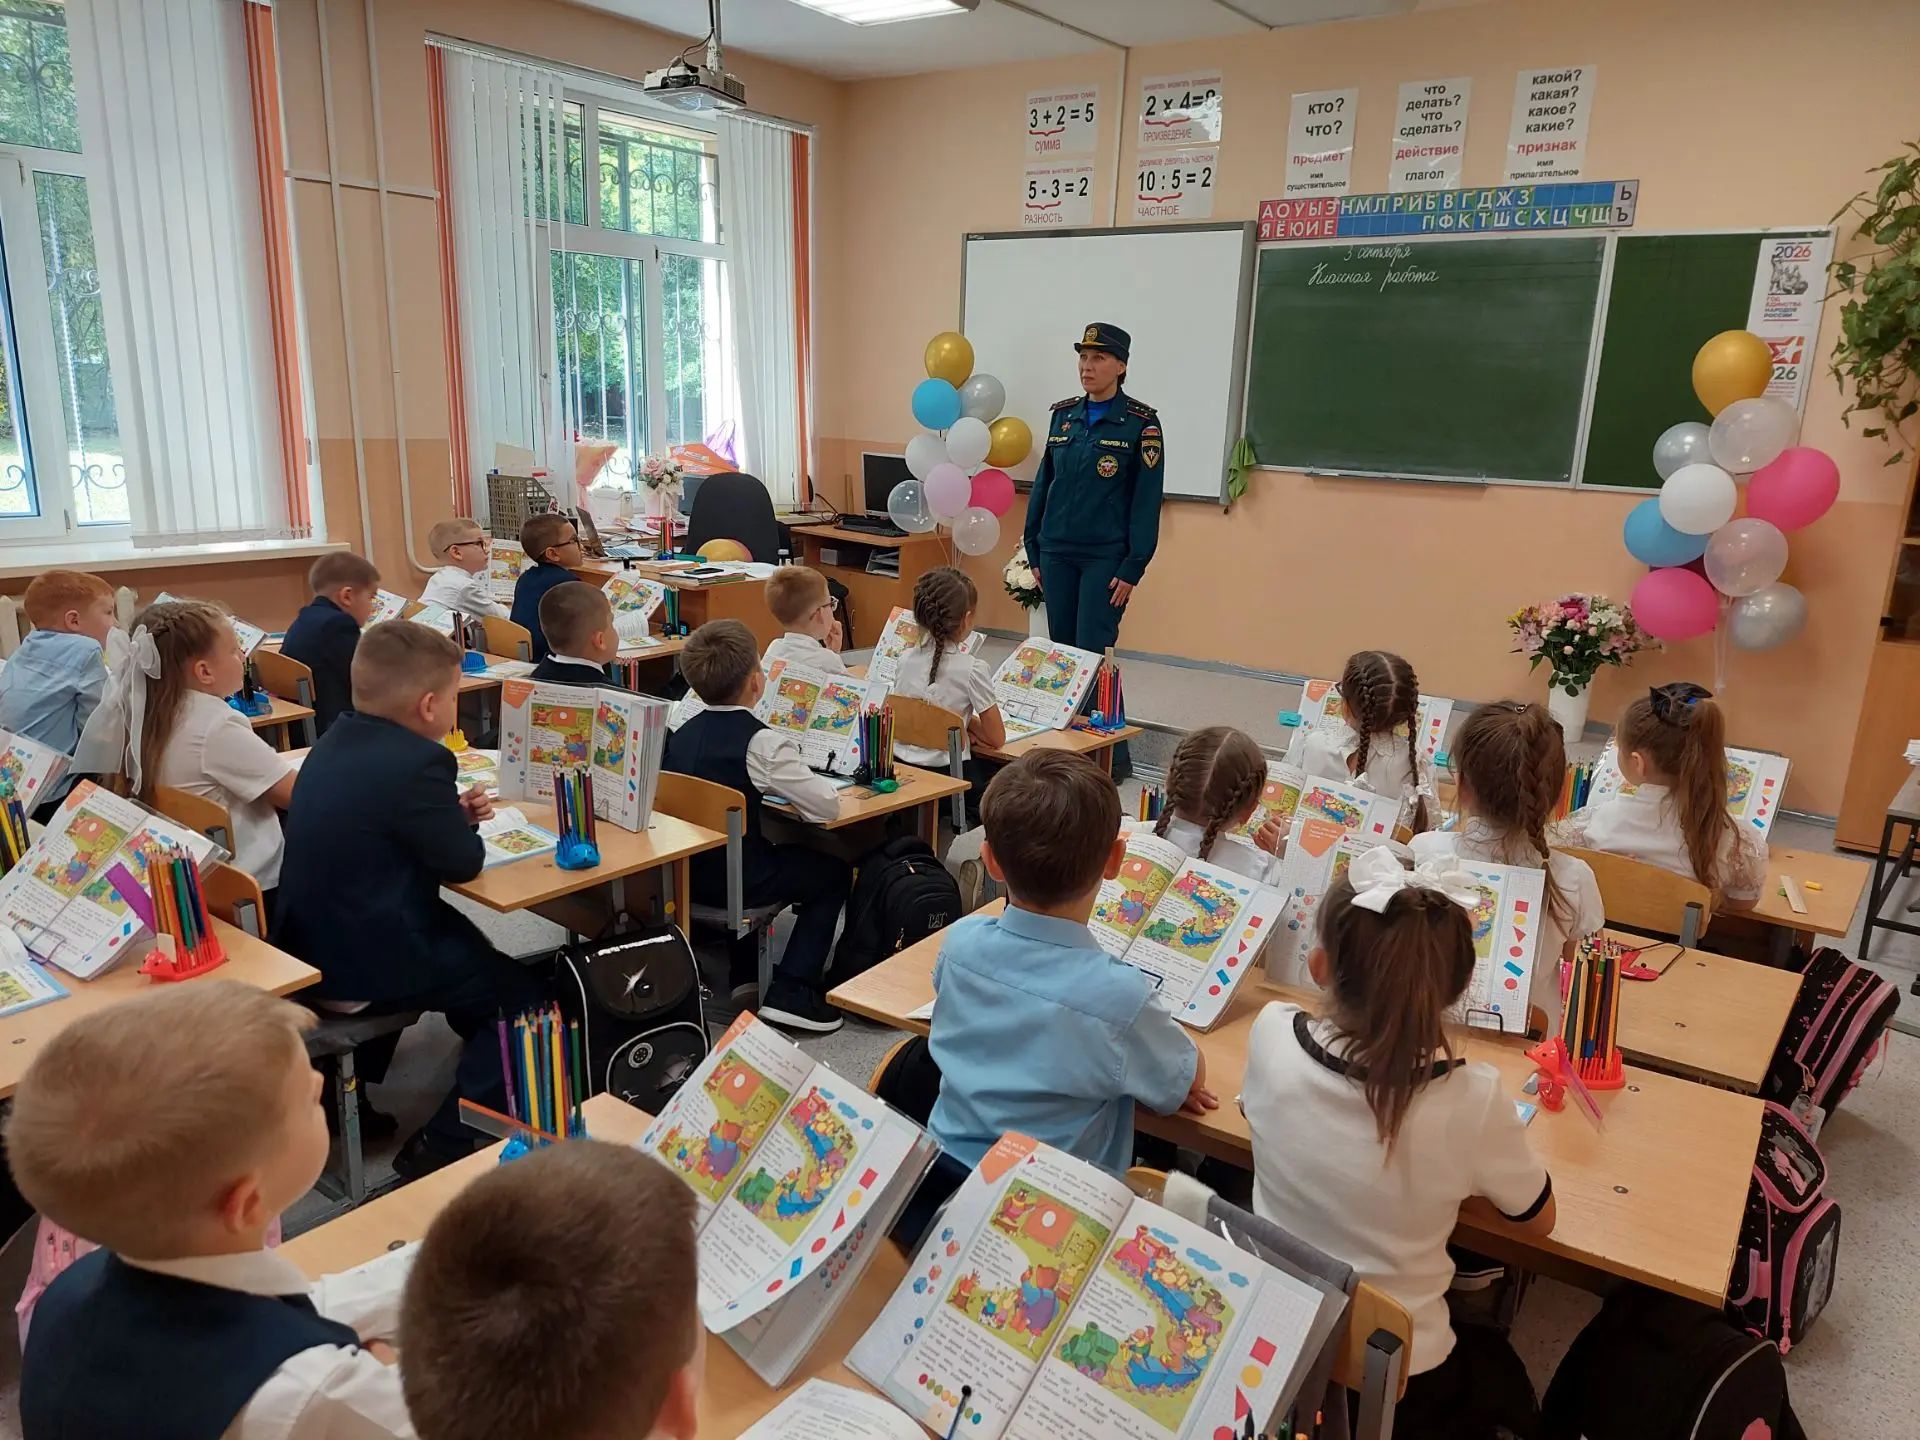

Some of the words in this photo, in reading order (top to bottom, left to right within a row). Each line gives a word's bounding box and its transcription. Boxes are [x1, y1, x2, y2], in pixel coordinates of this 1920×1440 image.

[1532, 69, 1582, 85] какой?
[1424, 85, 1446, 95] что
[1530, 85, 1579, 101] какая?
[1146, 96, 1156, 116] 2
[1308, 98, 1344, 115] кто?
[1406, 94, 1461, 112] делать?
[1528, 102, 1576, 117] какое?
[1030, 109, 1038, 128] 3
[1057, 106, 1065, 125] 2
[1085, 103, 1094, 122] 5
[1421, 111, 1442, 121] что
[1306, 120, 1342, 136] что?
[1400, 120, 1461, 137] сделать?
[1525, 119, 1574, 133] какие?
[1144, 128, 1192, 142] ПРОИЗВЕДЕНИЕ
[1395, 145, 1459, 160] действие
[1517, 141, 1577, 156] признак
[1293, 152, 1345, 166] предмет
[1536, 159, 1554, 167] имя
[1138, 171, 1155, 191] 10
[1171, 169, 1181, 189] 5
[1201, 167, 1212, 187] 2
[1405, 170, 1444, 181] глагол
[1510, 168, 1579, 180] прилагательное
[1029, 181, 1037, 199] 5
[1052, 179, 1060, 198] 3
[1079, 177, 1089, 196] 2
[1287, 181, 1346, 191] существительное
[1138, 205, 1180, 216] ЧАСТНОЕ
[1025, 213, 1063, 224] РАЗНОСТЬ
[1775, 245, 1812, 258] 2026
[1308, 262, 1373, 285] Классная
[1379, 265, 1439, 292] работа
[1773, 366, 1798, 380] 26
